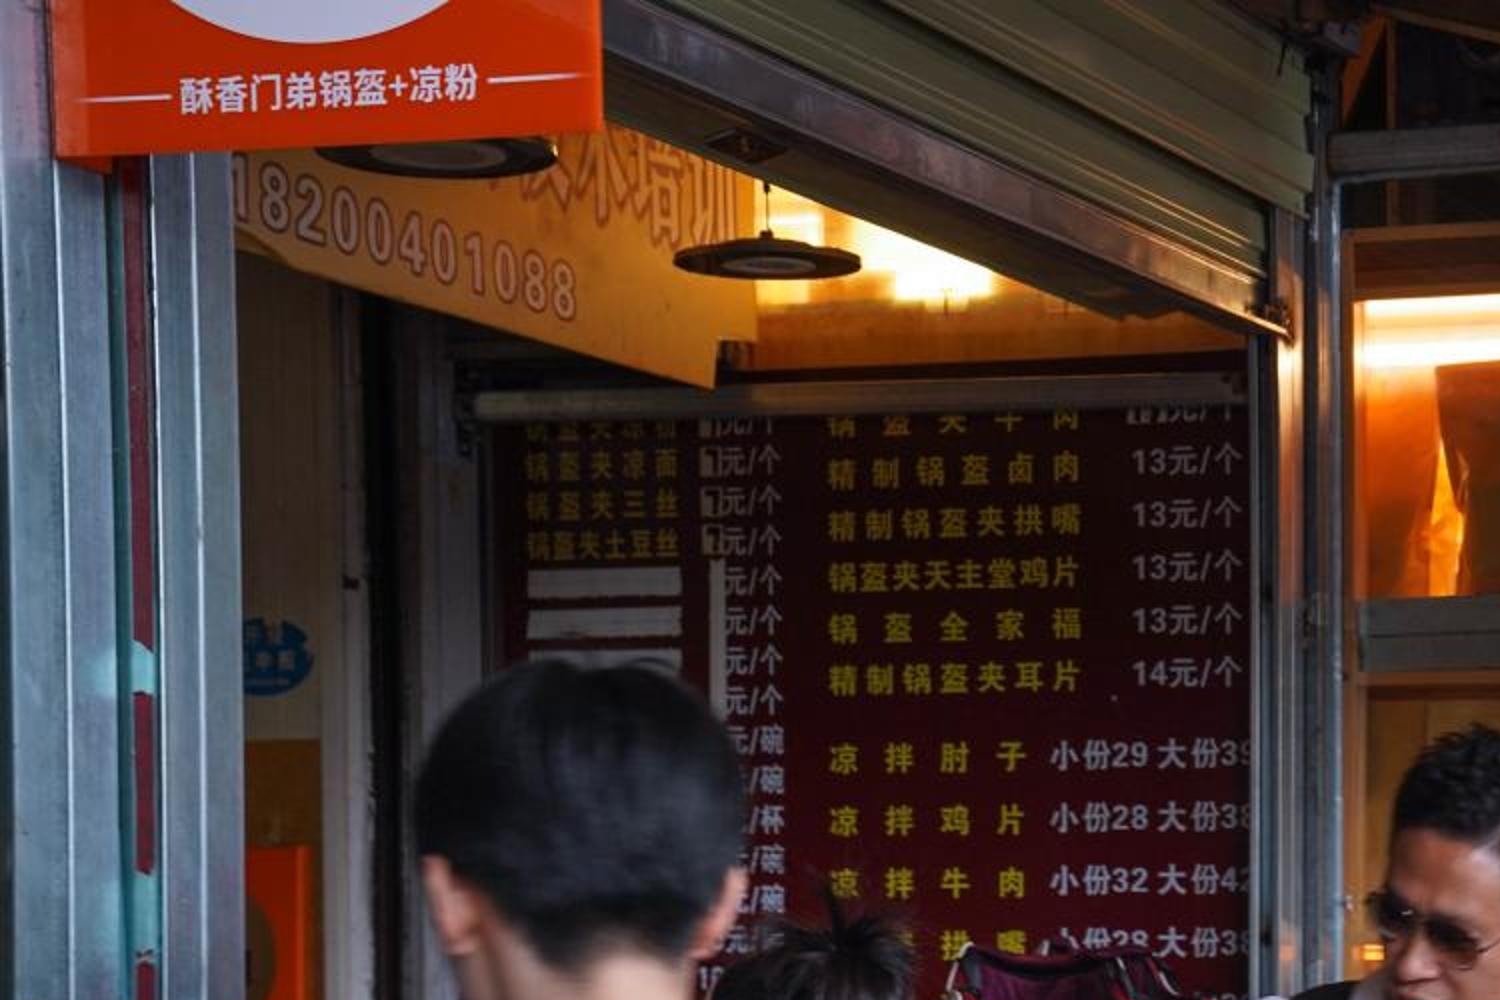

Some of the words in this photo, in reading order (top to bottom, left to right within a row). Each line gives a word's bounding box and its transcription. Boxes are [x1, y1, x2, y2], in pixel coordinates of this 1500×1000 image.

[179, 63, 478, 115] 酥香门弟锅盔+凉粉
[230, 152, 577, 322] 18200401088
[827, 450, 1082, 491] 精制锅盔卤肉
[1131, 442, 1243, 476] 13元/个
[1131, 495, 1243, 529] 13元/个
[828, 556, 1081, 593] 锅盔夹天主堂鸡片
[1131, 548, 1243, 582] 13元/个
[828, 607, 1083, 645] 锅盔全家福
[1131, 602, 1243, 636] 13元/个
[828, 658, 1082, 697] 精制锅盔夹耳片
[1131, 655, 1243, 689] 14元/个
[829, 740, 1027, 776] 凉拌肘子
[1050, 739, 1149, 771] 小份29
[829, 804, 1026, 838] 凉拌鸡片
[1050, 802, 1149, 834] 小份28
[829, 866, 1026, 900] 凉拌牛肉
[1050, 865, 1149, 897] 小份32
